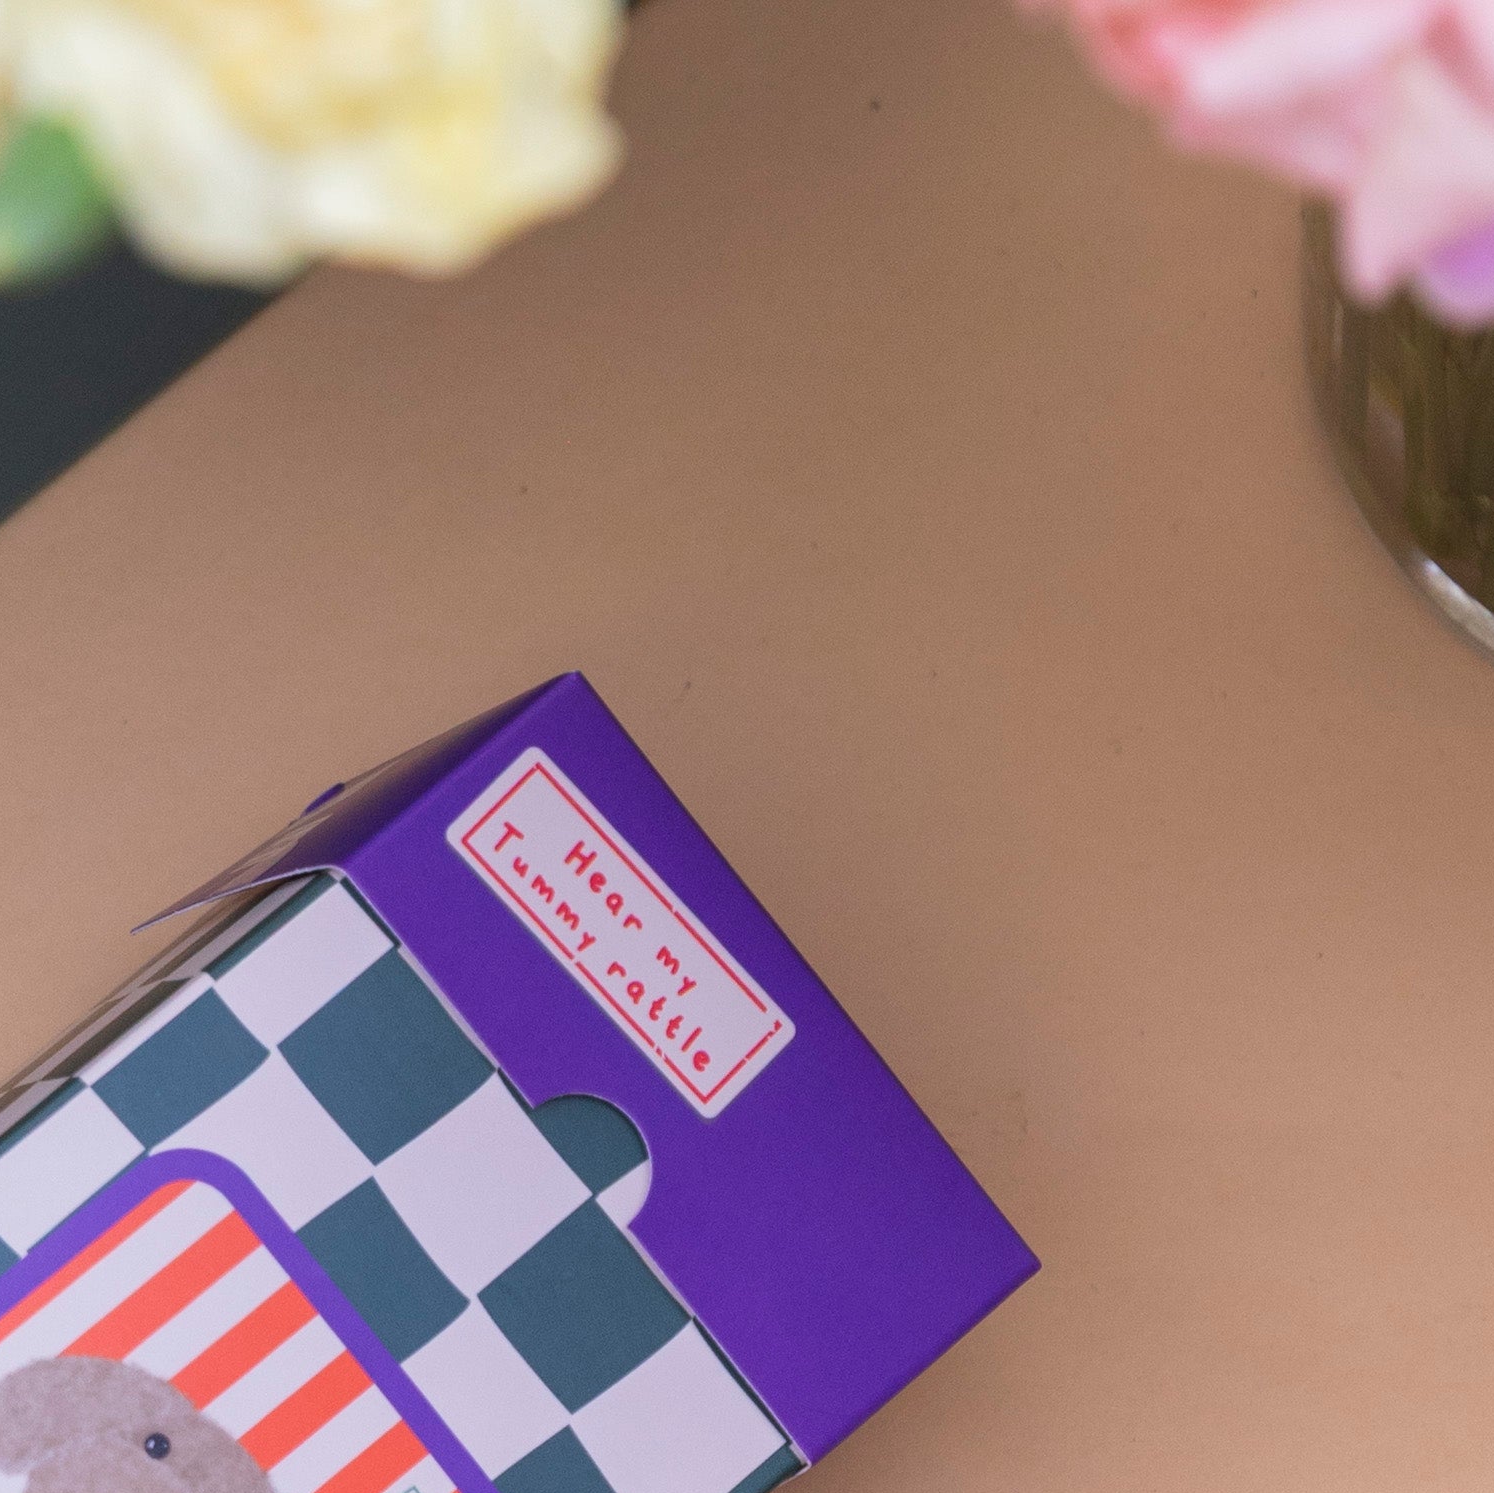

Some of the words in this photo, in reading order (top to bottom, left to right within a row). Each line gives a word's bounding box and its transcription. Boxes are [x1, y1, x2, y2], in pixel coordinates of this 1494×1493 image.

[493, 822, 596, 952] Tummy
[607, 960, 711, 1072] rattle
[564, 840, 643, 932] Hear
[656, 946, 697, 997] my
